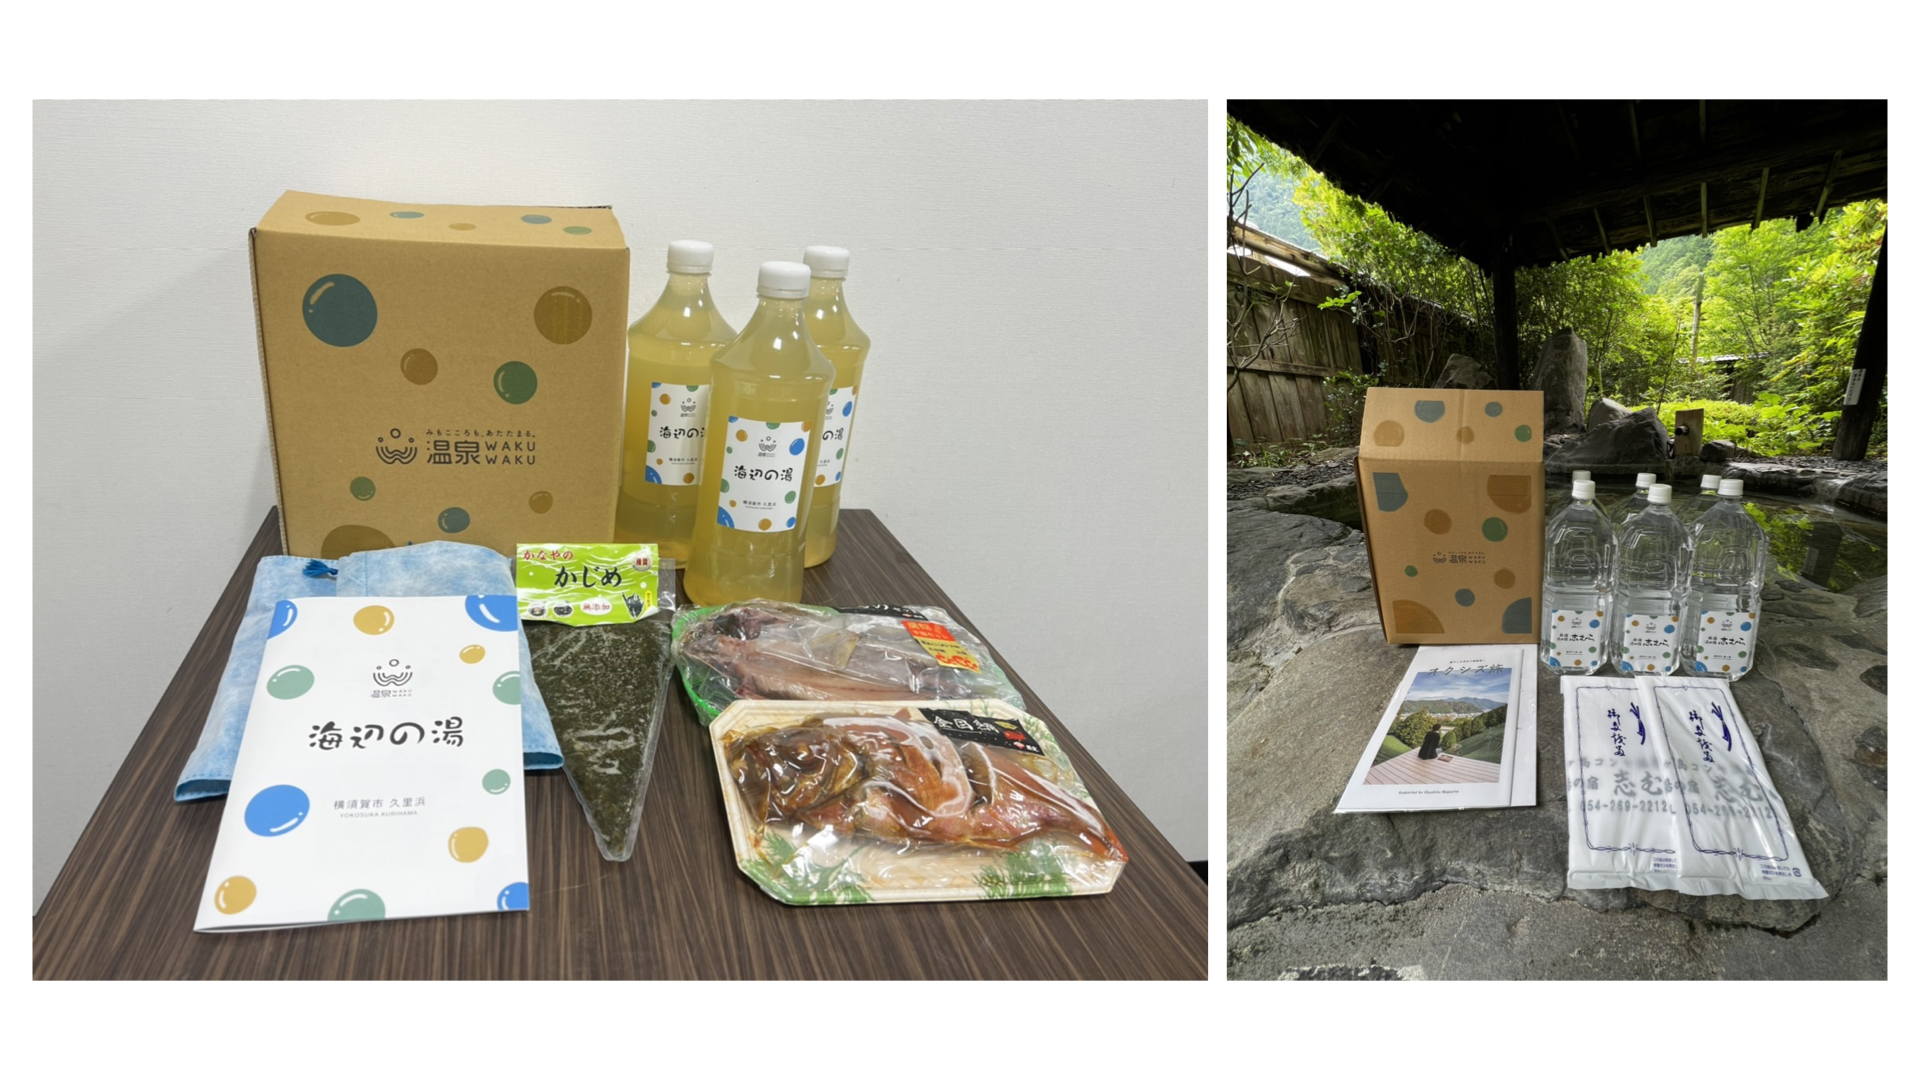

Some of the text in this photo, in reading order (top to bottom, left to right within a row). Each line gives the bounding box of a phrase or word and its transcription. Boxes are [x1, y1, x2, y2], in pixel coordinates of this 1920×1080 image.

[426, 429, 537, 438] みもこころも、あたたまる。
[427, 440, 537, 465] 温泉 WAKU
[485, 454, 537, 465] WAKU
[734, 464, 794, 482] 海辺の湯
[523, 550, 574, 561] かなやの
[554, 566, 622, 588] かじめ
[582, 603, 611, 612] 無添加
[1427, 663, 1505, 677] オクシズ旅
[370, 689, 391, 698] 温泉
[308, 716, 464, 751] 海辺の湯
[333, 796, 427, 810] 横須賀市 久里浜
